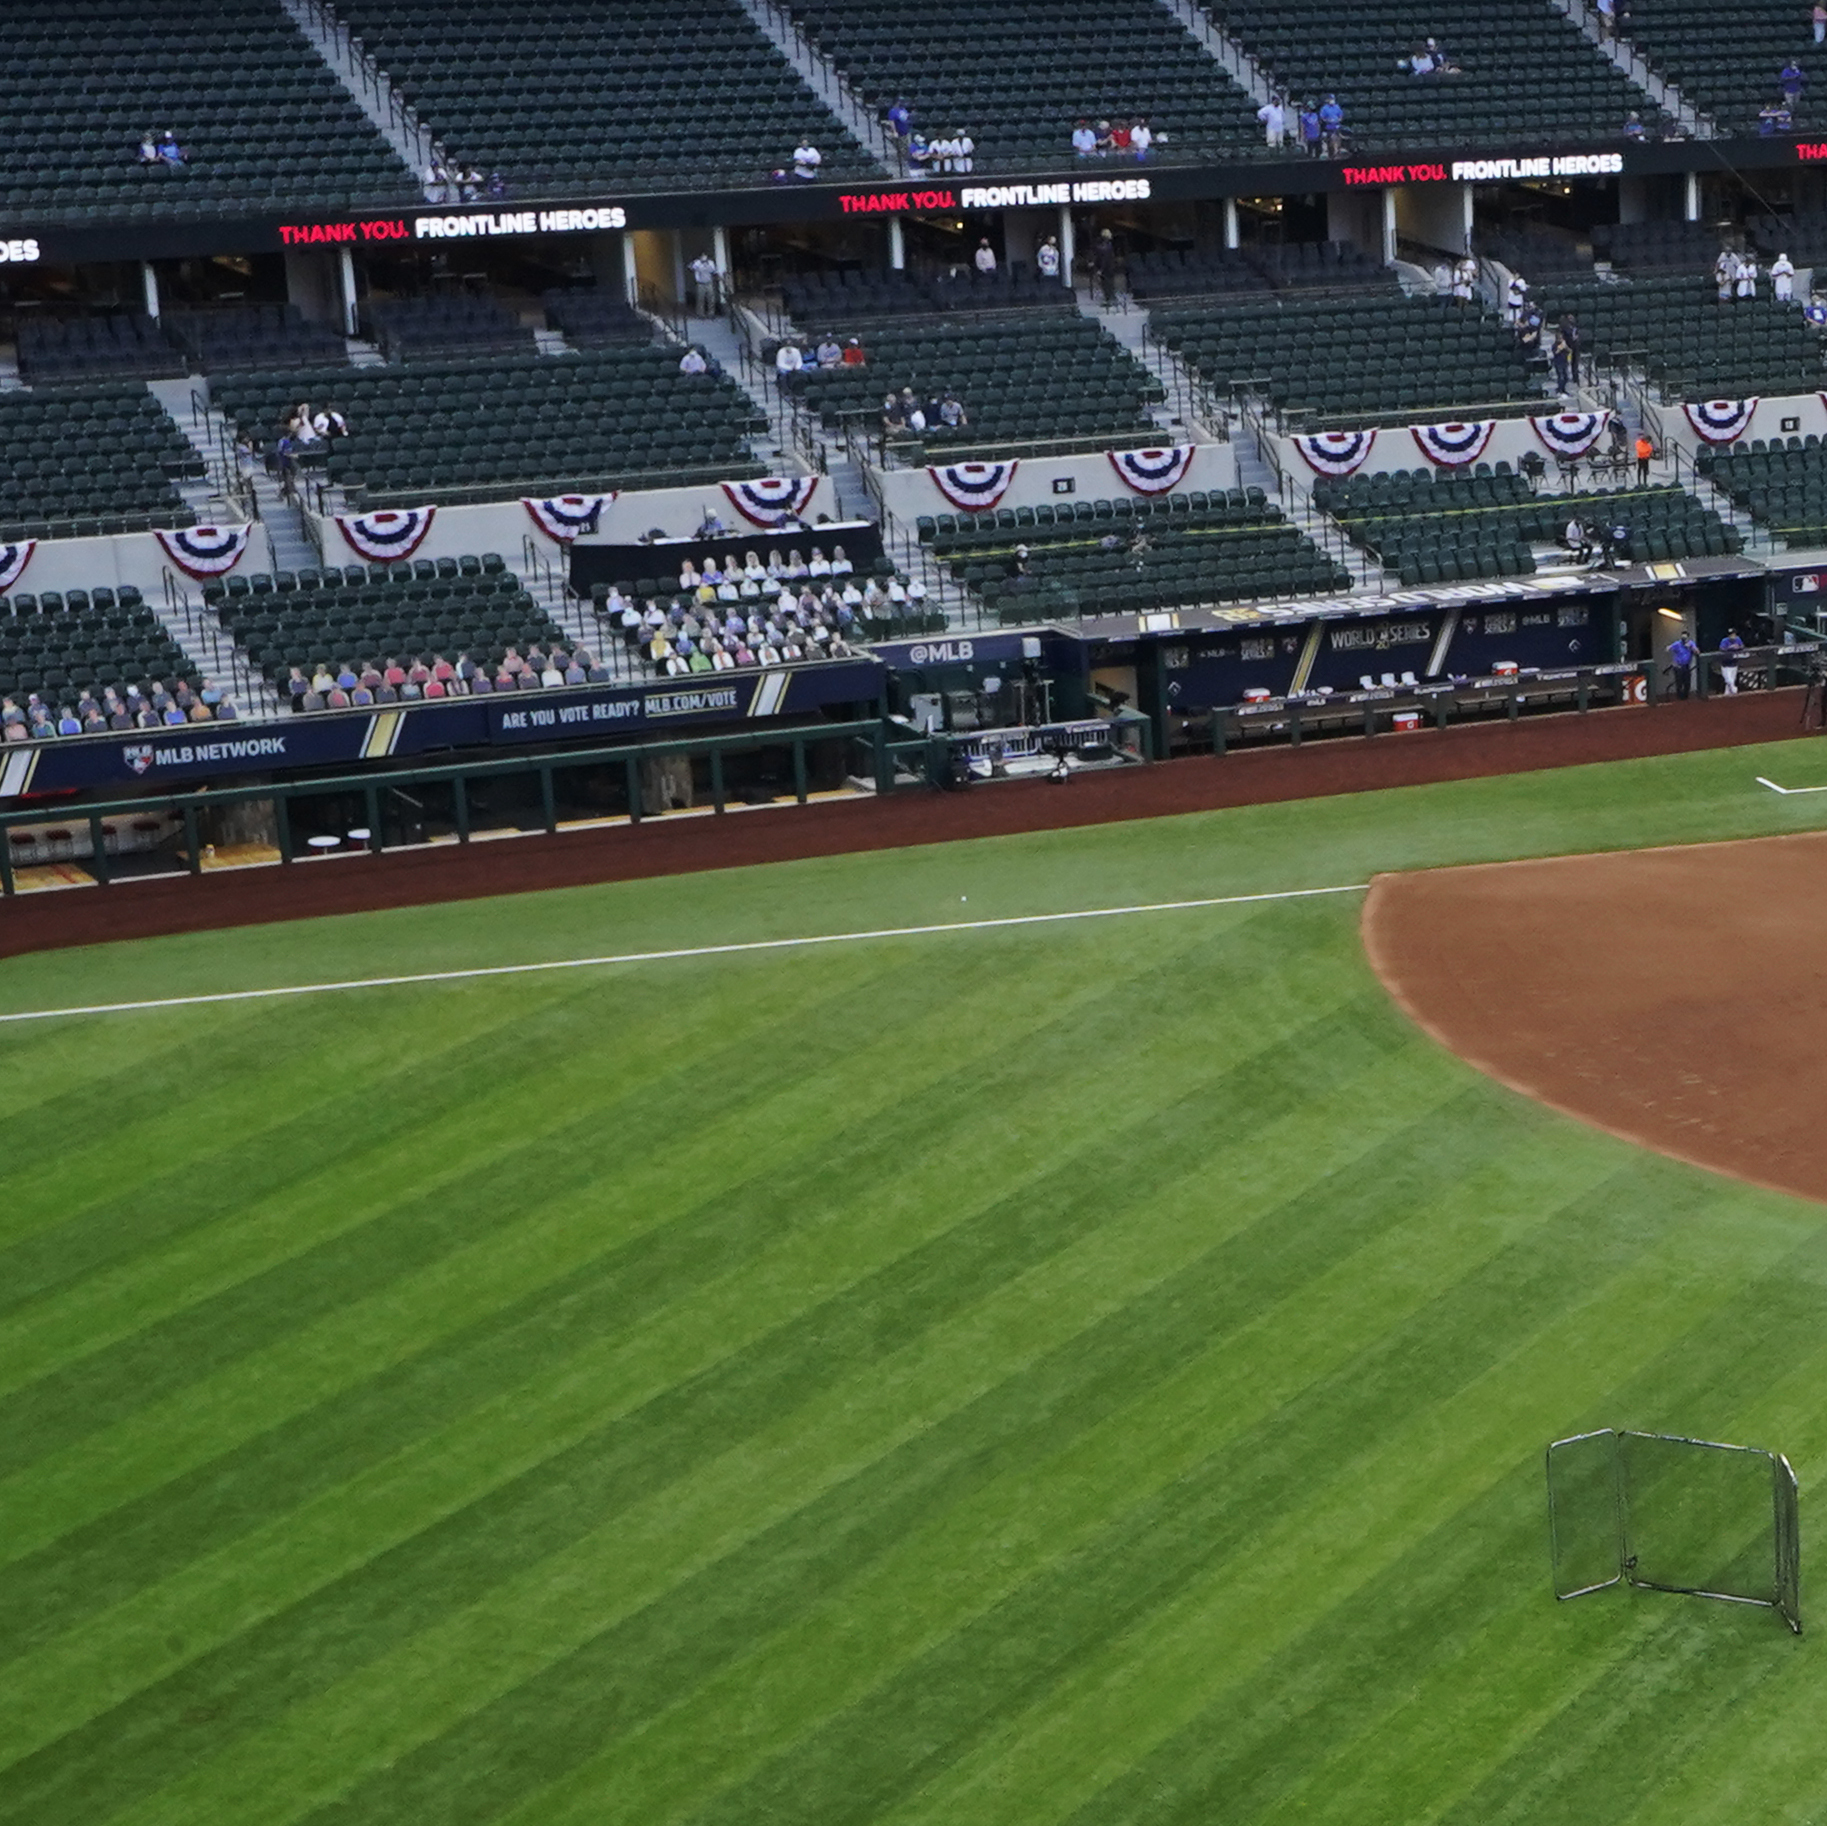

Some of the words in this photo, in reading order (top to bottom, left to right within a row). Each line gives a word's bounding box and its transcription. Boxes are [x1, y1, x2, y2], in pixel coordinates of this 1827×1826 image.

[1342, 165, 1405, 185] THANK
[1407, 164, 1447, 181] YOU.
[1451, 157, 1550, 180] FRONTLINE
[1553, 153, 1623, 175] HEROES
[839, 192, 910, 213] THANK
[911, 191, 956, 209] YOU.
[961, 185, 1071, 208] FRONTLINE
[1072, 179, 1151, 202] HEROES
[280, 225, 356, 245] THANK
[359, 220, 409, 242] YOU.
[415, 214, 537, 239] FRONTLINE
[540, 208, 626, 232] HEROES
[1330, 627, 1375, 650] WORLD
[1389, 622, 1432, 642] SERIES
[910, 640, 975, 666] @MLB
[502, 712, 528, 730] ARE
[530, 709, 556, 727] YOU
[559, 706, 590, 725] VOTE
[593, 701, 640, 723] READY?
[644, 689, 738, 715] MLB.COM/VOTE
[155, 747, 194, 766] MLB
[195, 736, 287, 762] NETWORK
